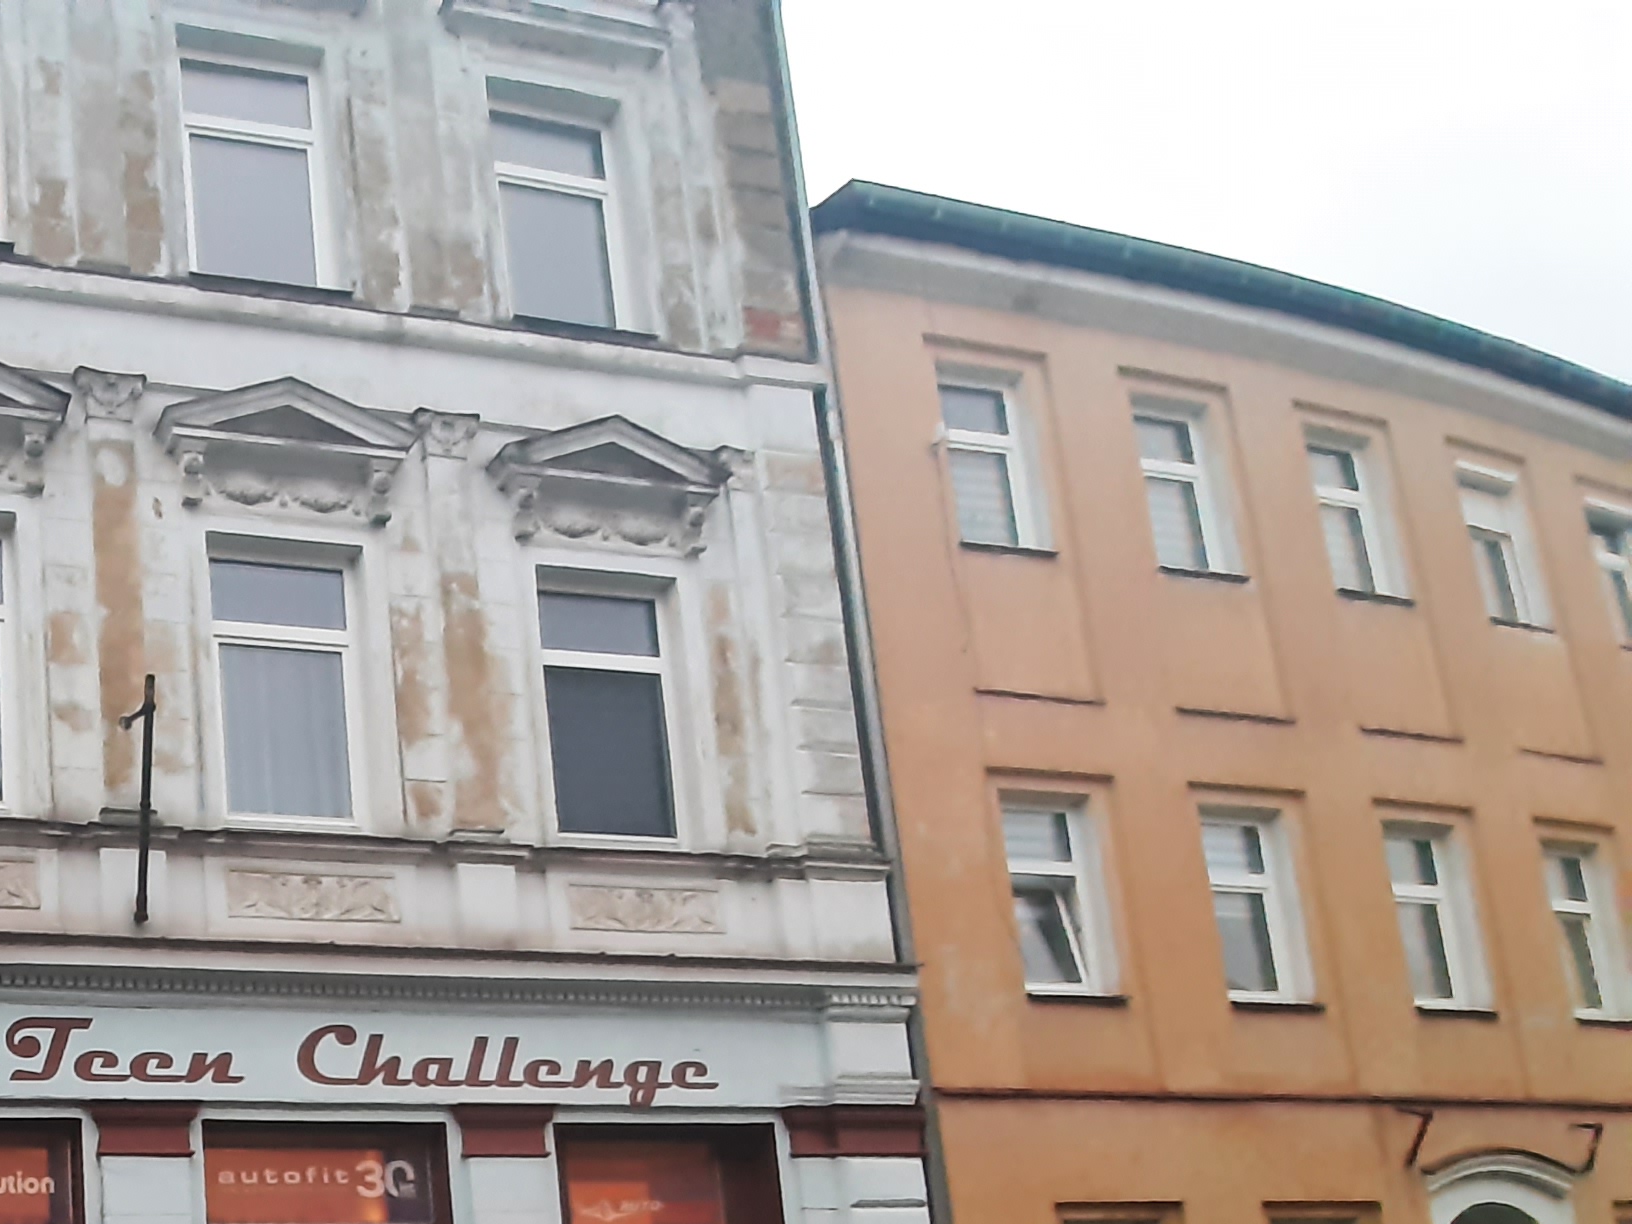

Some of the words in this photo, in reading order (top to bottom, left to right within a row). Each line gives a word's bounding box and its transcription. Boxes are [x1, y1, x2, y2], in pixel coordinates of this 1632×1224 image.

[5, 1016, 245, 1082] Teen
[296, 1024, 718, 1107] Challenge
[218, 1165, 349, 1184] autofit
